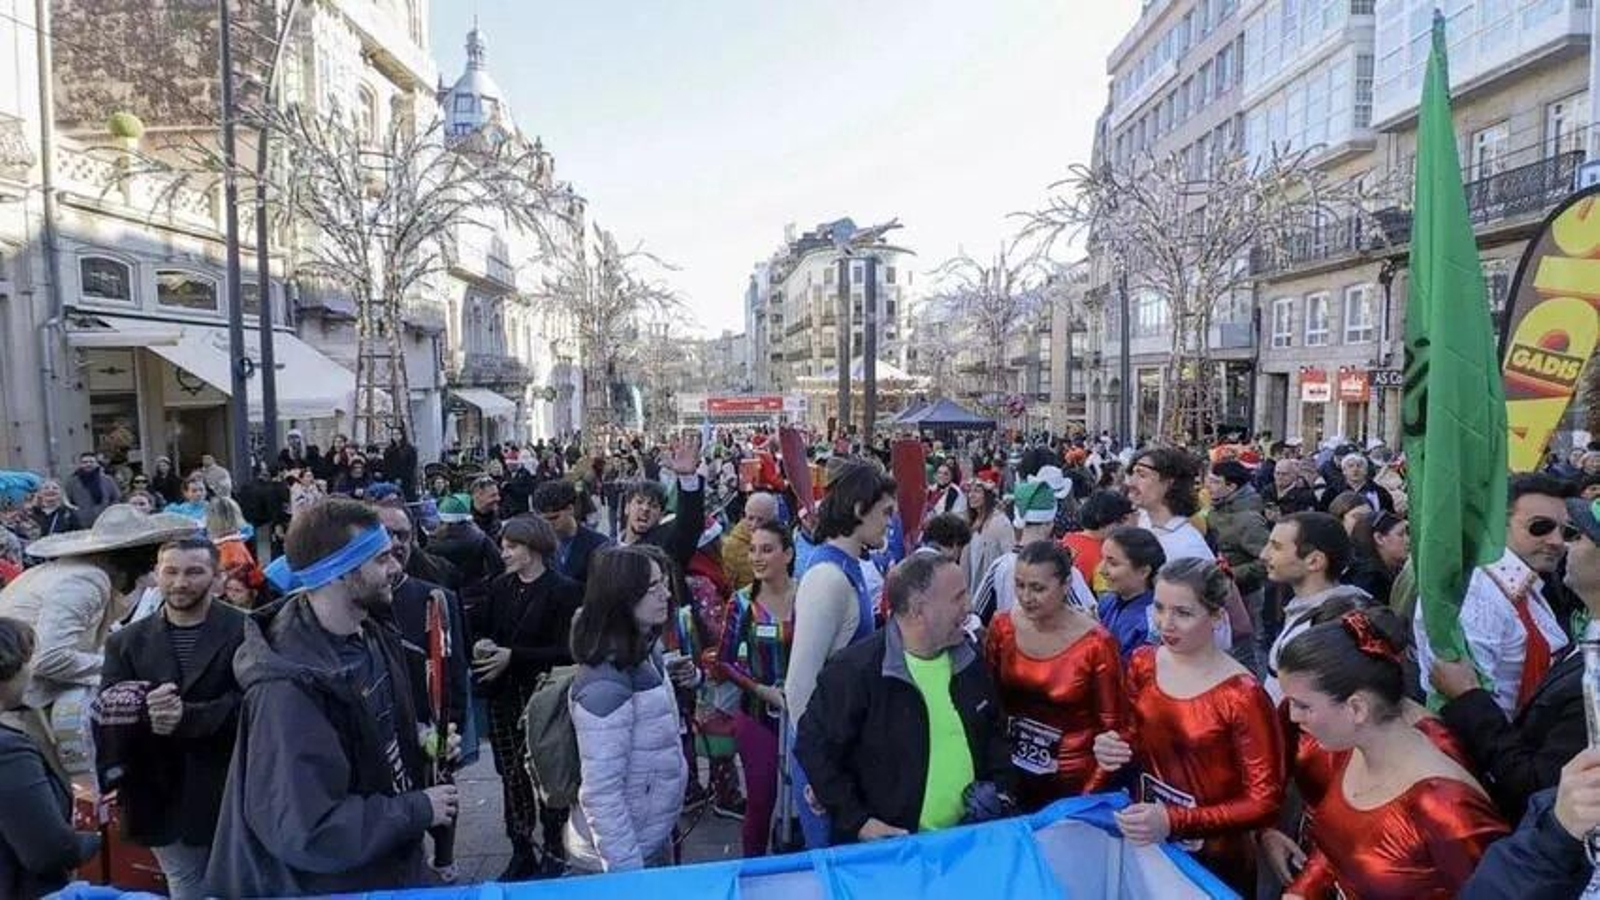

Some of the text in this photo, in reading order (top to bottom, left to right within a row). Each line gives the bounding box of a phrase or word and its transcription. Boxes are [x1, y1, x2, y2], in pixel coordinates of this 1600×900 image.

[1374, 371, 1387, 385] AS
[1512, 349, 1580, 380] GADIS
[1018, 740, 1050, 767] 329
